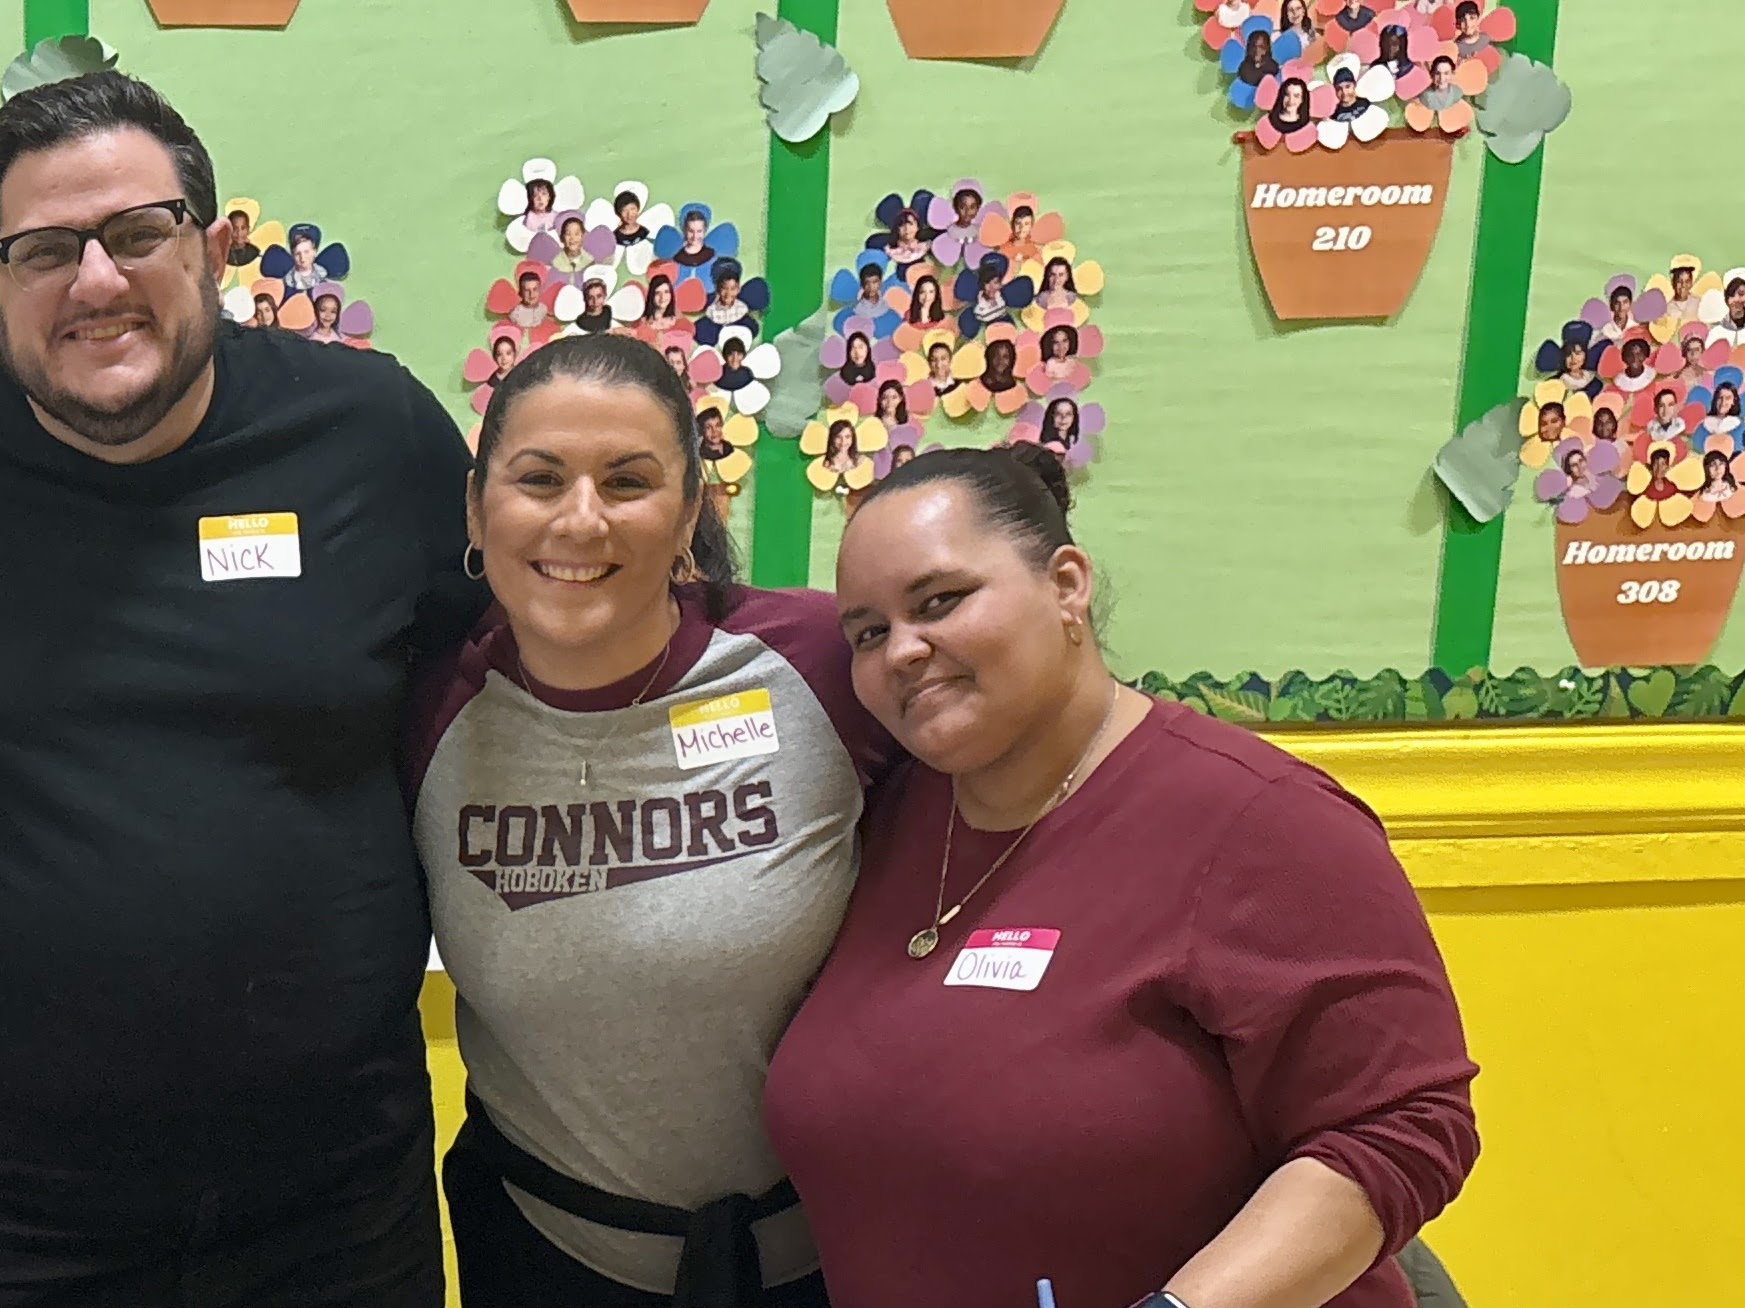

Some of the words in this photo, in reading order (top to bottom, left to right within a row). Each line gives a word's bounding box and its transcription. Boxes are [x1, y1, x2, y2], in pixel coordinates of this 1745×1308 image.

[1250, 182, 1434, 209] Homeroom
[1312, 225, 1373, 251] 210
[227, 516, 270, 530] HELLO
[1562, 539, 1736, 565] Homeroom
[1616, 579, 1681, 605] 308
[676, 716, 775, 759] Michelle
[458, 780, 779, 867] CONNORS
[496, 867, 607, 893] HOBOKEN
[991, 930, 1032, 942] HELLO
[957, 951, 1028, 981] Olivia
